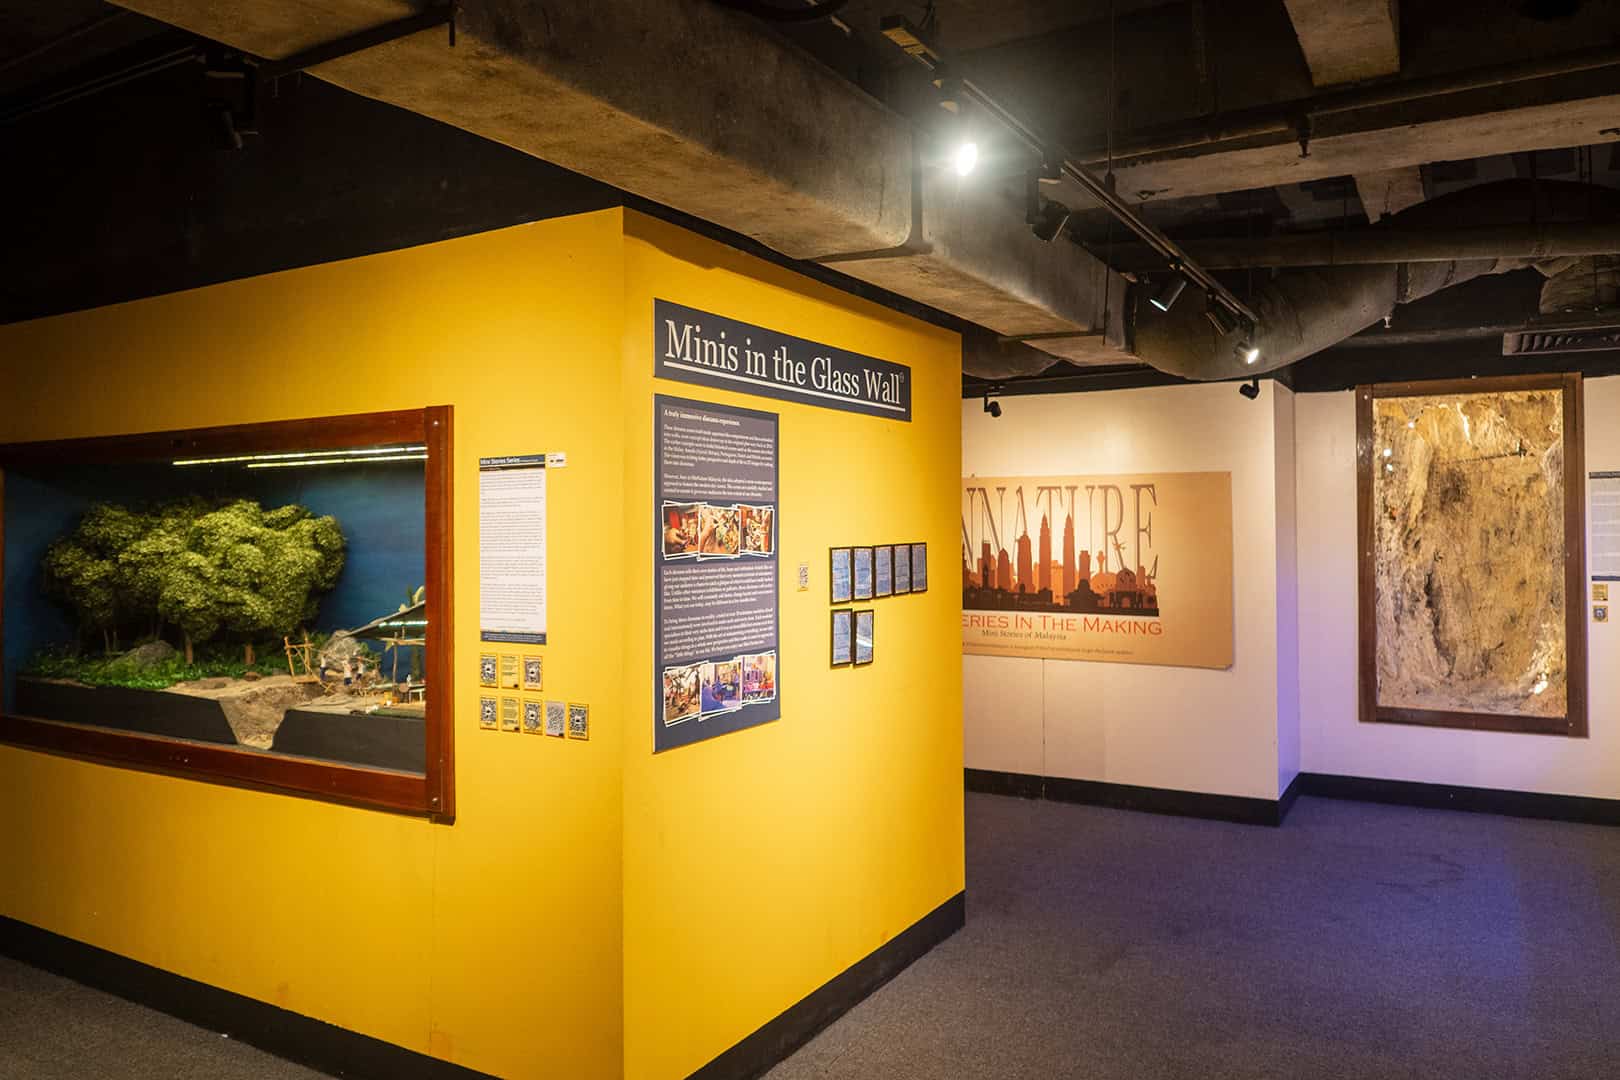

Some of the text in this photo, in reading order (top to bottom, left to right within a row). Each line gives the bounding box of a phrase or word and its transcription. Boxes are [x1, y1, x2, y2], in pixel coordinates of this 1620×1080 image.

[665, 319, 739, 372] Minis
[745, 338, 768, 378] in
[772, 346, 807, 385] the
[811, 357, 860, 397] Glass
[1015, 614, 1033, 630] IN
[1038, 615, 1078, 632] THE
[1083, 616, 1163, 636] MAKING
